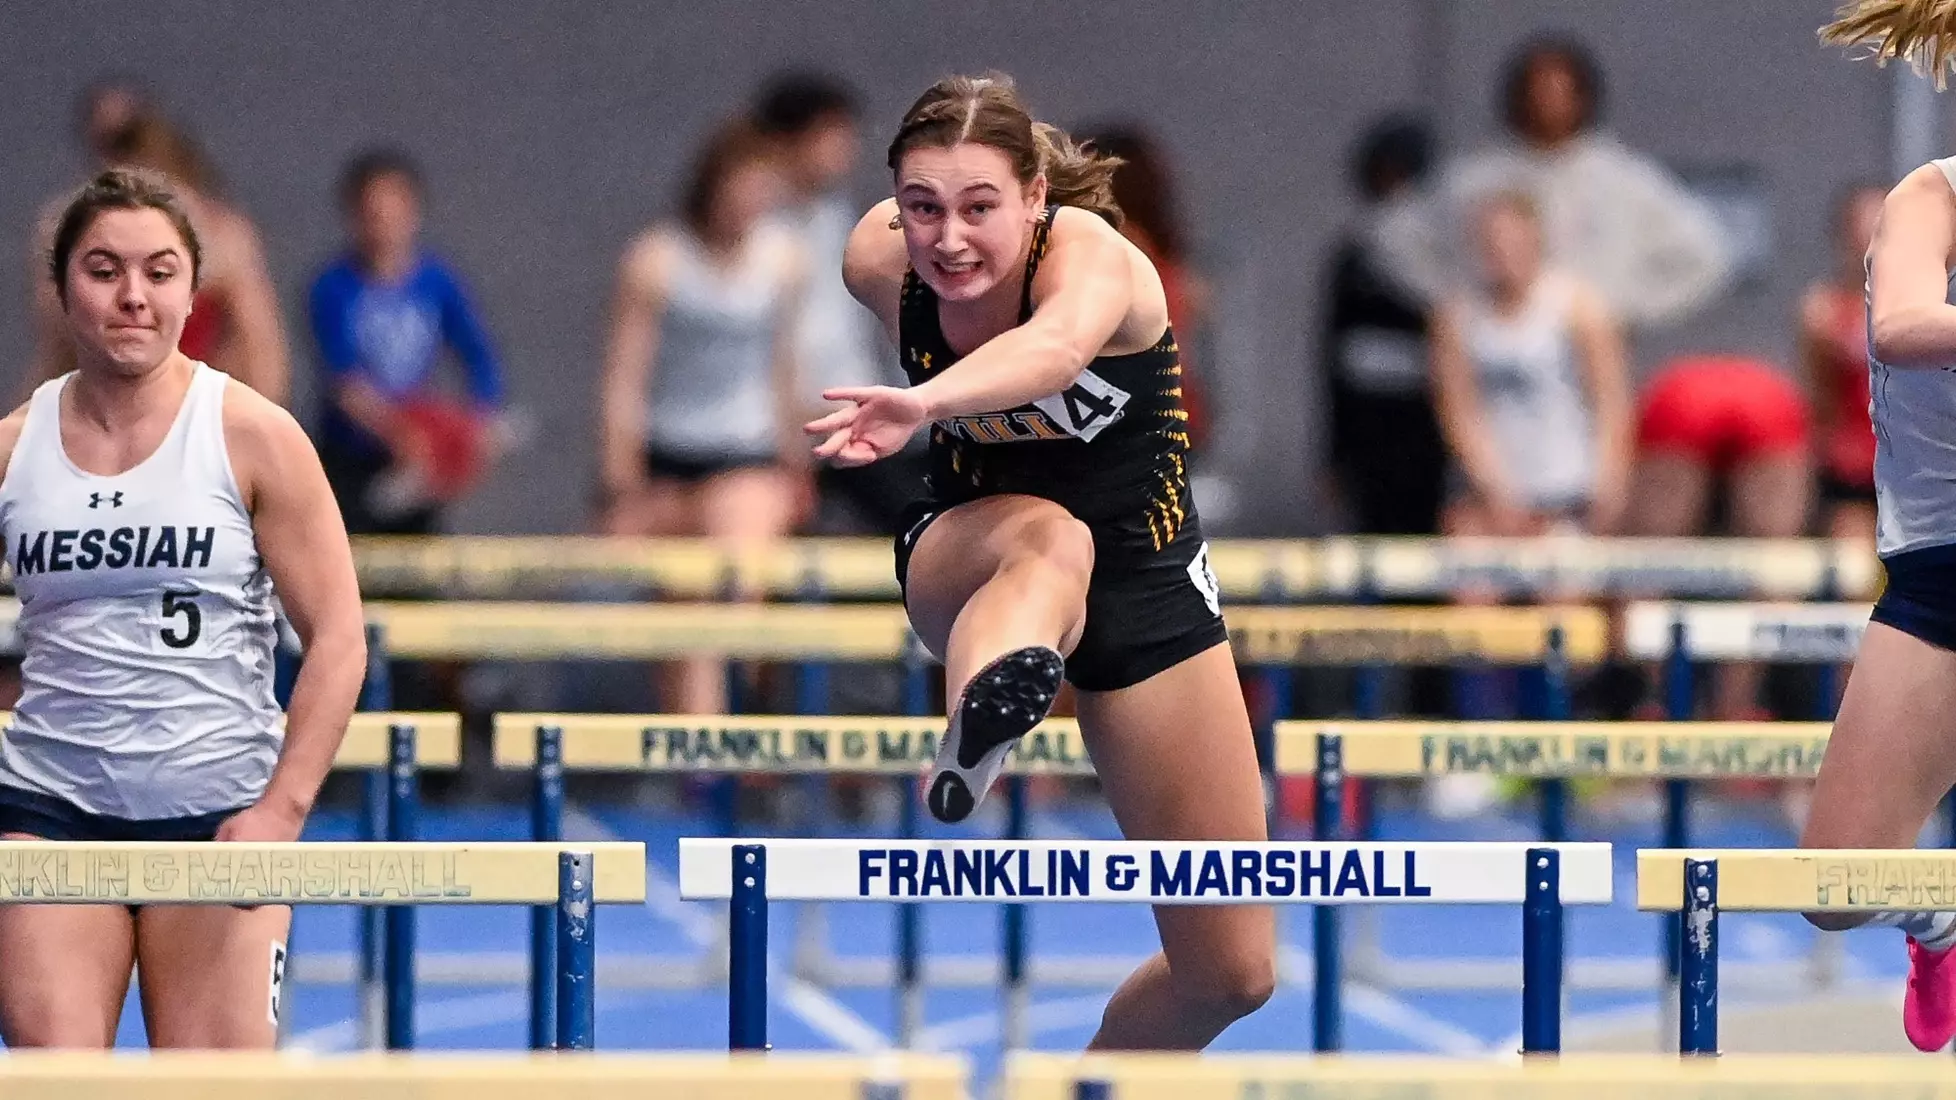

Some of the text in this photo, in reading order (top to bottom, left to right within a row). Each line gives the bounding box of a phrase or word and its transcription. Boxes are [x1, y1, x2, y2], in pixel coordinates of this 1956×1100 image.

[1063, 381, 1117, 432] 4
[16, 526, 215, 576] MESSIAH
[159, 589, 201, 649] 5
[143, 853, 180, 892] &
[188, 850, 472, 897] MARSHALL
[858, 849, 1432, 897] FRANKLIN & MARSHALL
